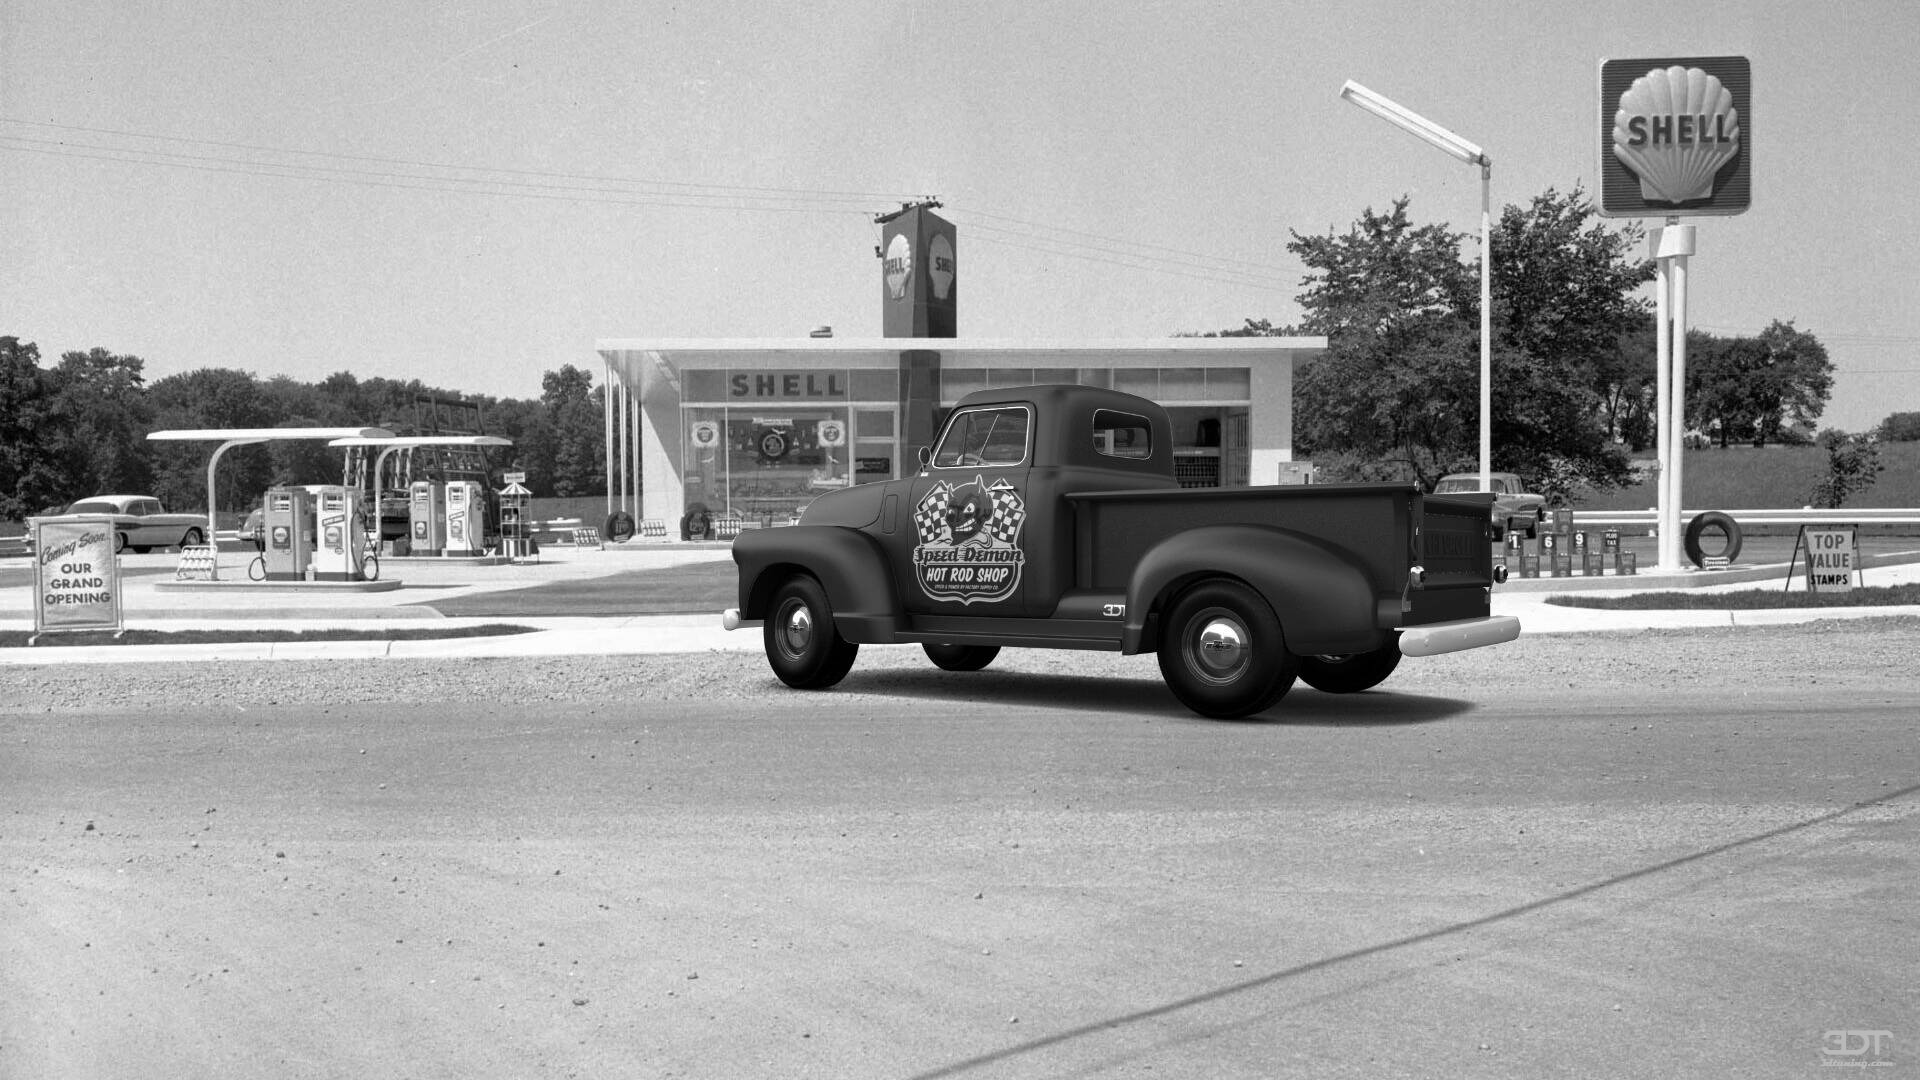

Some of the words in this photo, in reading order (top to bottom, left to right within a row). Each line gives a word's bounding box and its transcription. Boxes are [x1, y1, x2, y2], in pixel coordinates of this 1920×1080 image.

[1628, 114, 1730, 146] SHELL
[731, 374, 845, 397] SHELL
[1575, 533, 1584, 545] 9
[1814, 534, 1845, 550] TOP
[40, 540, 77, 566] Coming
[914, 547, 959, 565] Speed
[965, 547, 1023, 562] Demon
[1809, 553, 1850, 568] VALUE
[61, 563, 92, 574] OUR
[926, 567, 948, 582] HOT
[950, 567, 974, 582] ROD
[976, 567, 1009, 583] SHOP
[51, 577, 103, 589] GRAND
[1810, 574, 1849, 586] STAMPS
[45, 591, 111, 605] OPENING
